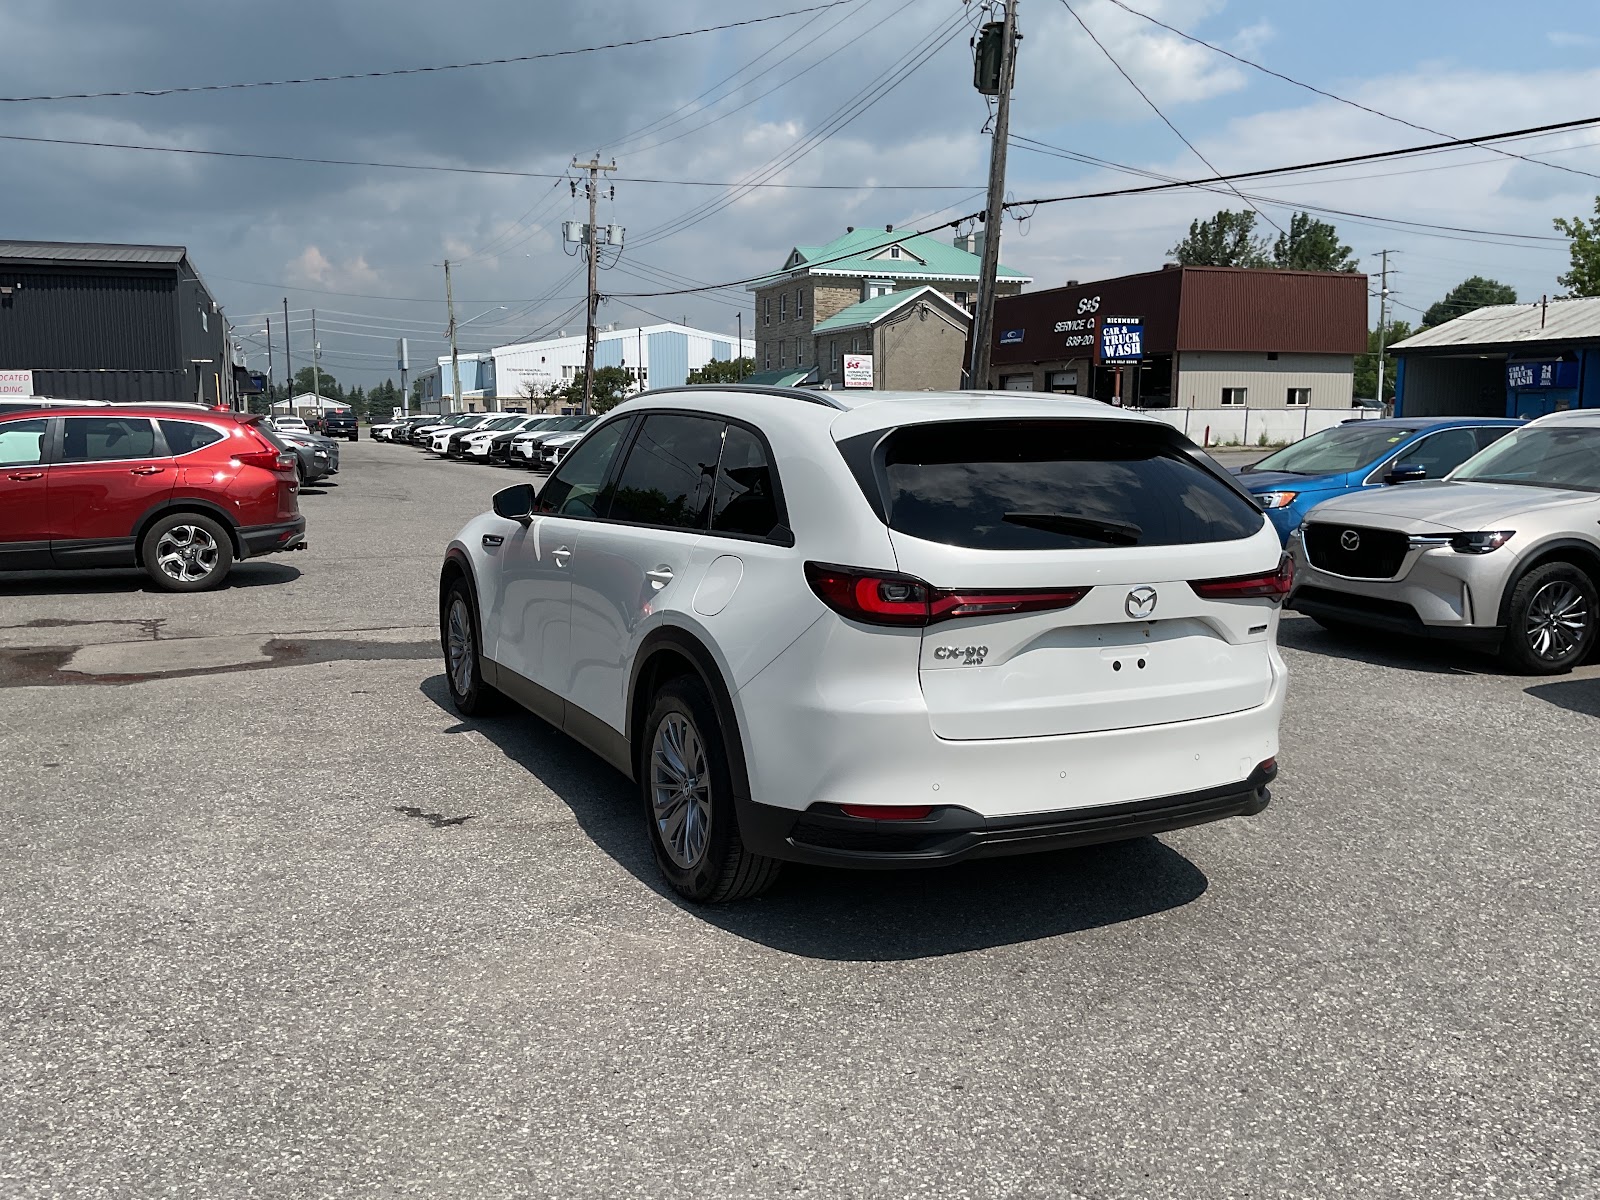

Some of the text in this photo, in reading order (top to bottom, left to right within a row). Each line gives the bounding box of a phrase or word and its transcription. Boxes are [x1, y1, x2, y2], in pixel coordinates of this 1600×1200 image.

[1077, 296, 1101, 315] S&S
[1054, 320, 1086, 332] SERVICE
[1103, 327, 1120, 336] CAR
[1104, 332, 1140, 346] TRUCK
[1104, 343, 1141, 358] WASH
[1509, 376, 1533, 387] WASH
[934, 645, 989, 660] CX-90
